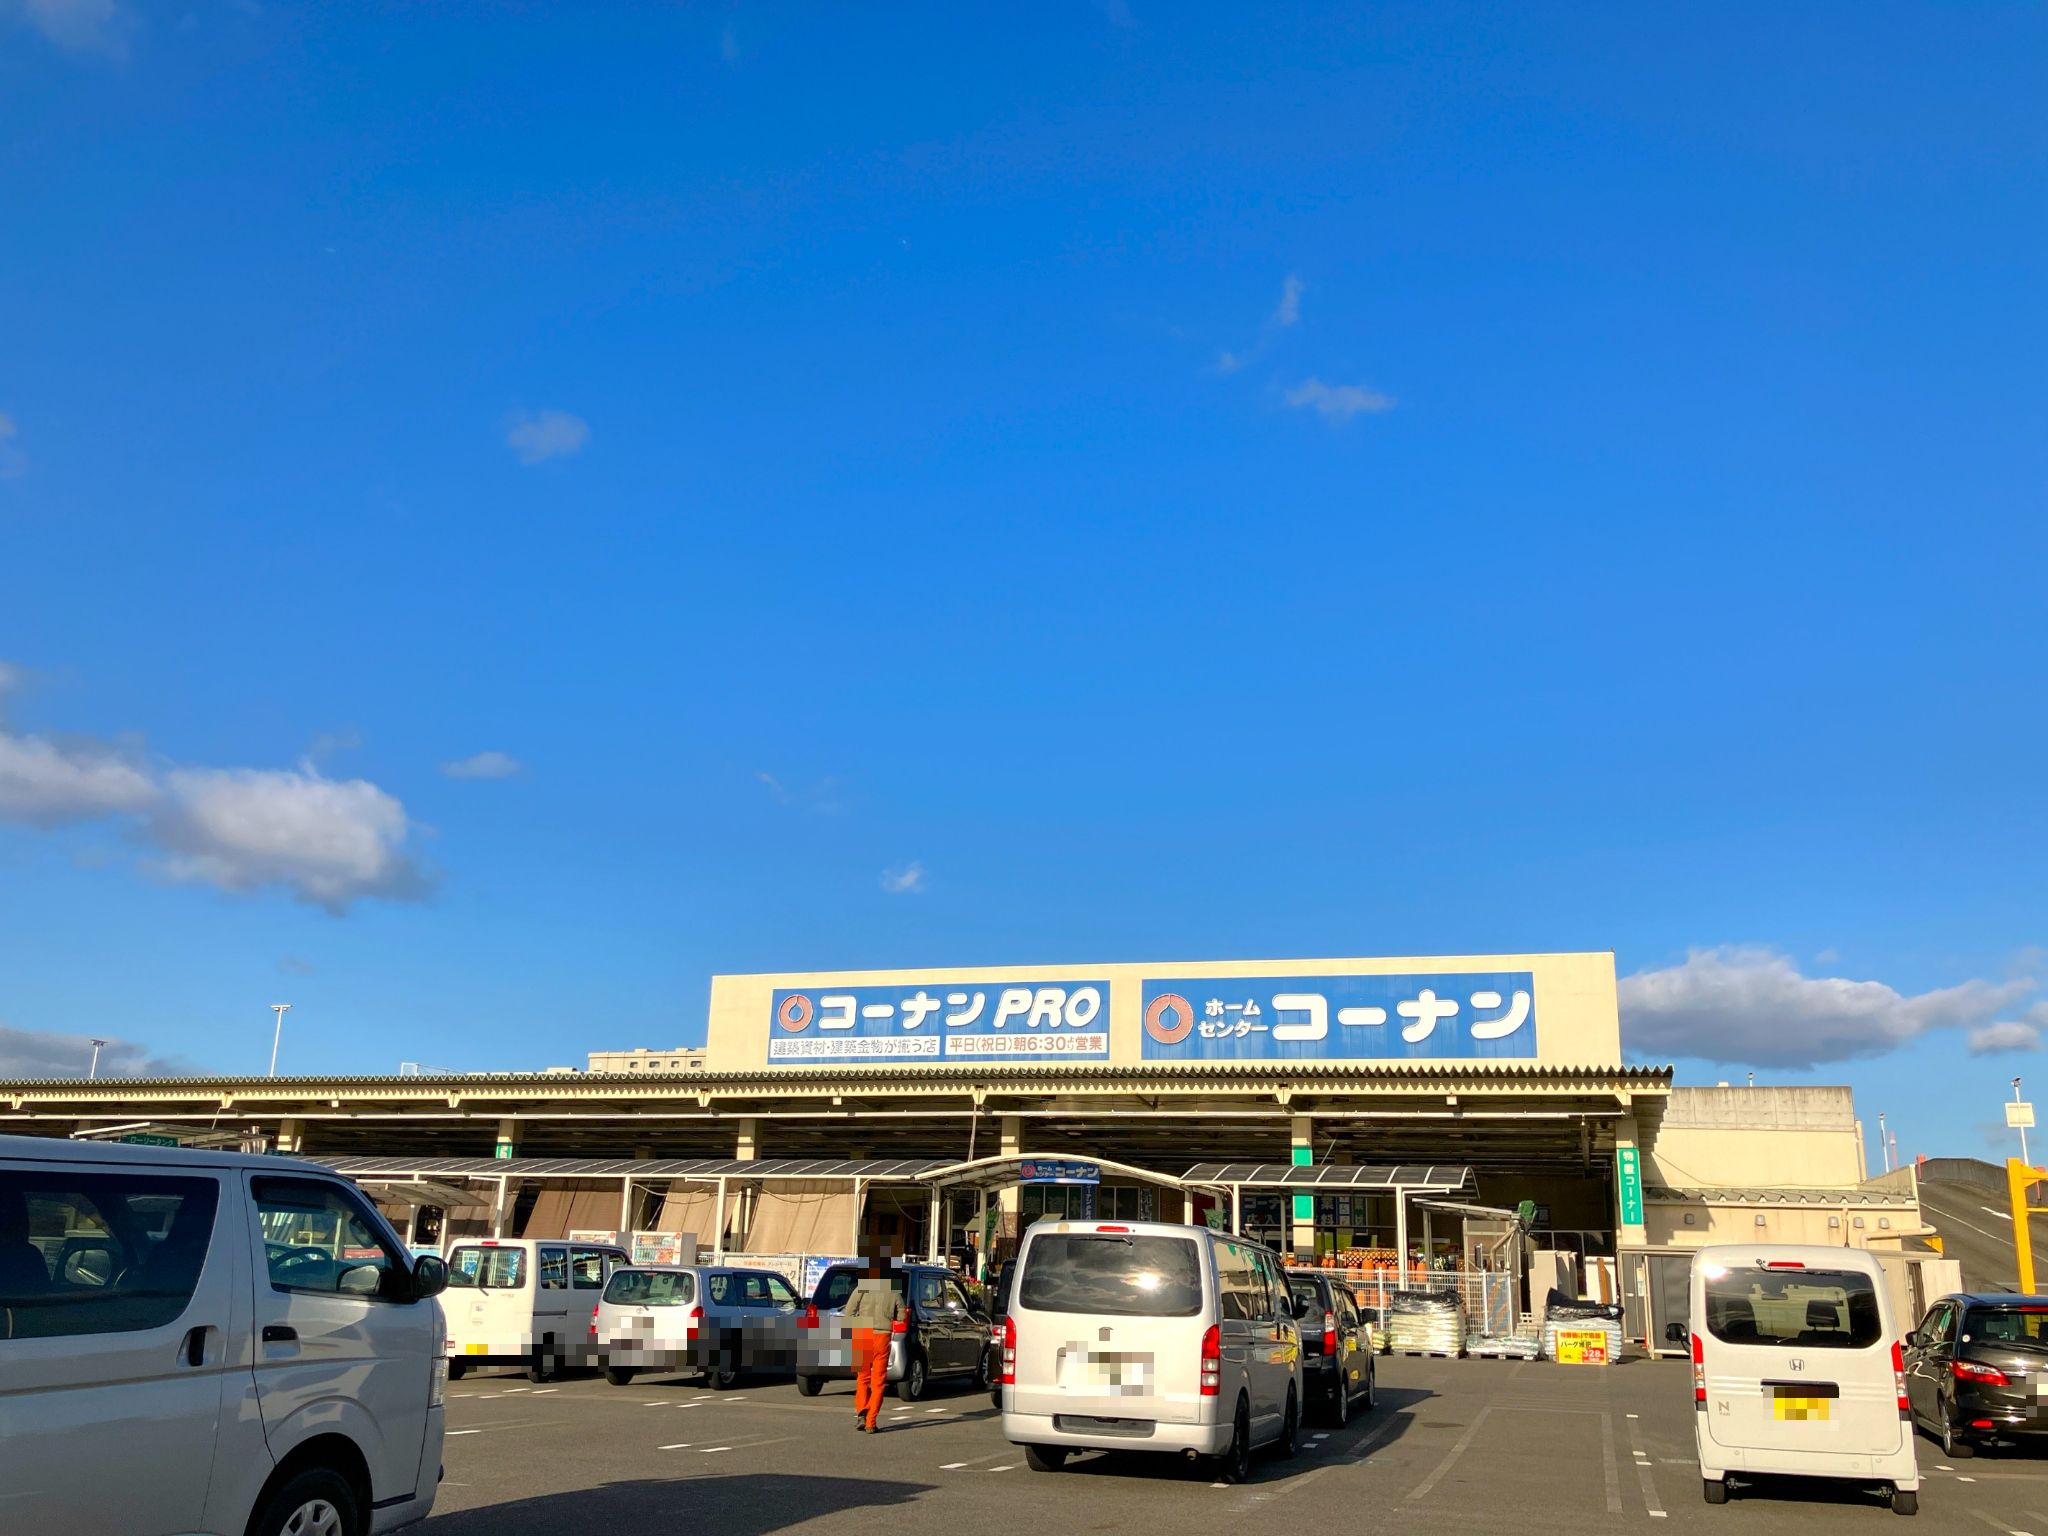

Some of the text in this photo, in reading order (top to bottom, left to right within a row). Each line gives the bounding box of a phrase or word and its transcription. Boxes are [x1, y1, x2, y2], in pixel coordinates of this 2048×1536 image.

[818, 987, 1101, 1030] コーナン PRO
[1205, 998, 1261, 1017] ホーム
[1272, 988, 1531, 1043] コーナン
[1198, 1018, 1269, 1038] センター
[1055, 1167, 1099, 1178] コーナン
